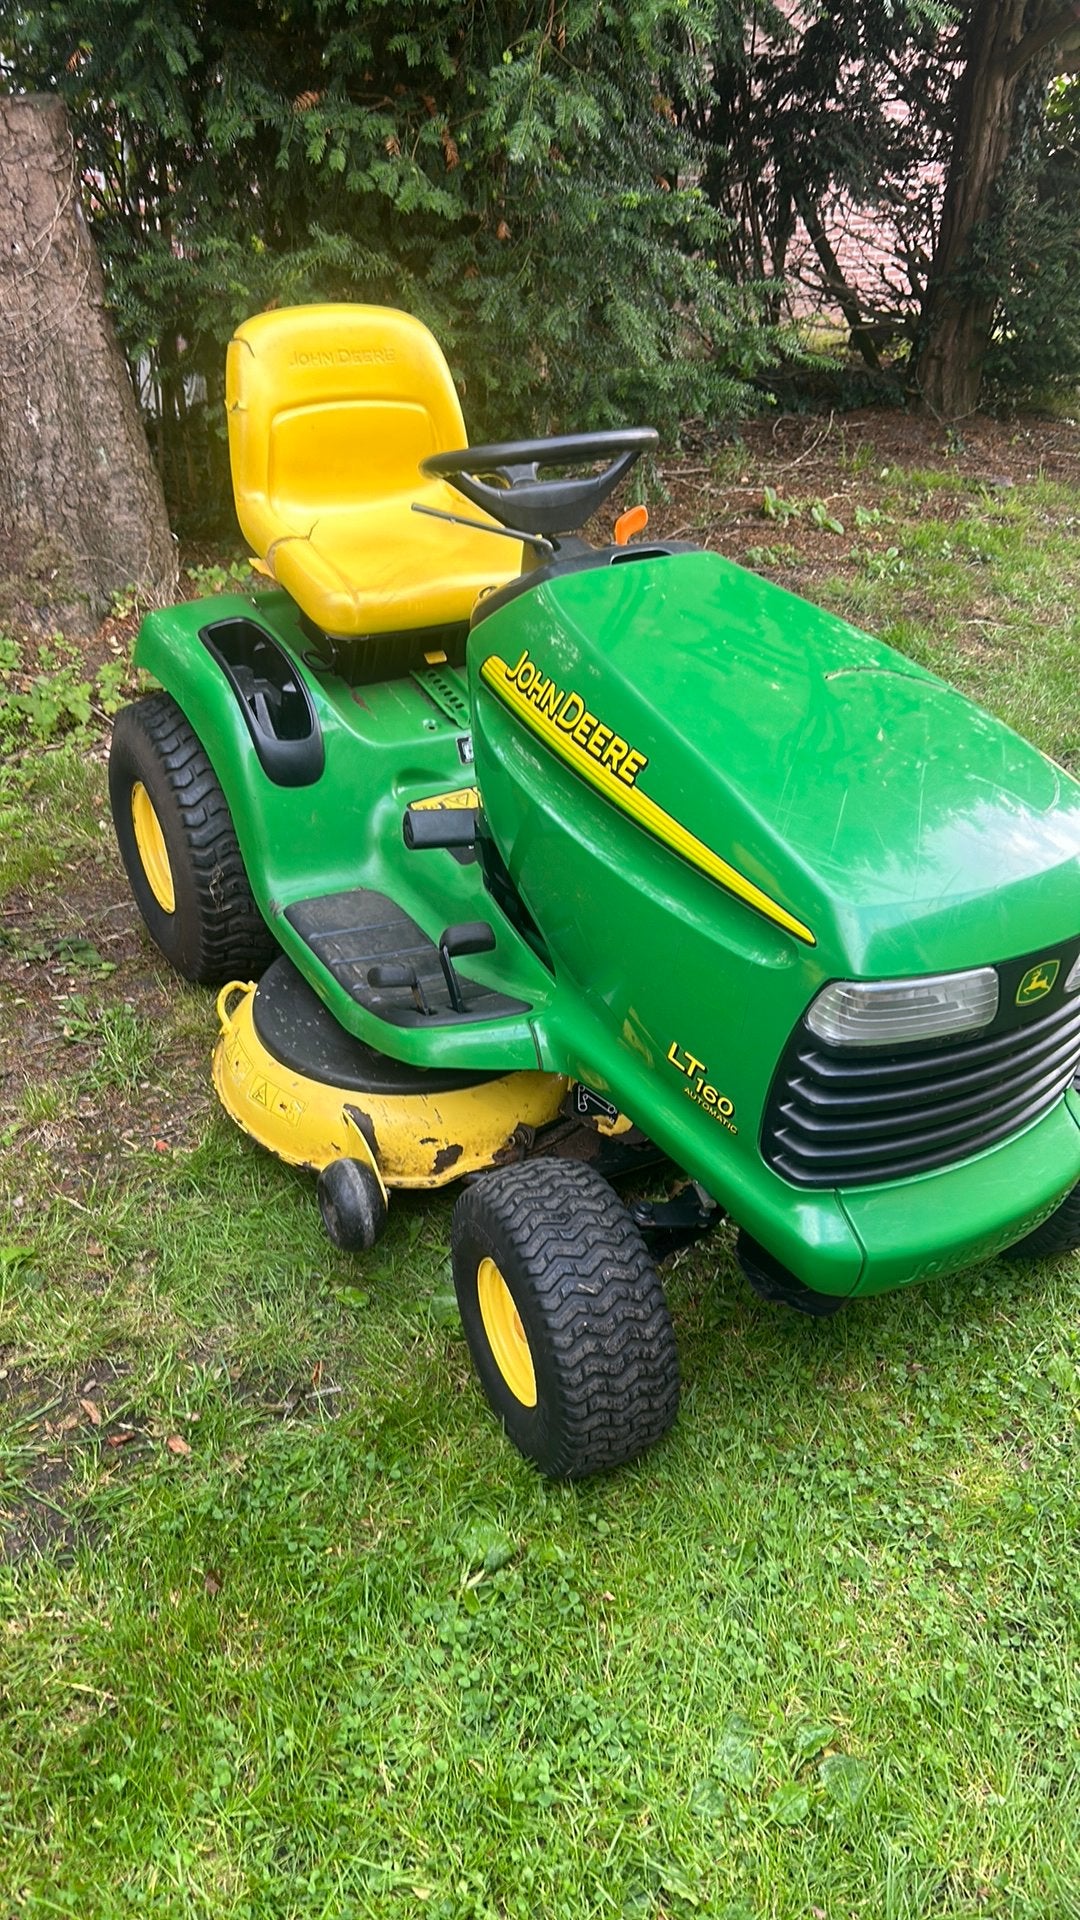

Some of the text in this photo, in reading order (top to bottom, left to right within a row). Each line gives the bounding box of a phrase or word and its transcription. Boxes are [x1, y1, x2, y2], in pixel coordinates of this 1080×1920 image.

[289, 347, 395, 367] JOHN DEERE
[506, 650, 648, 787] JOHN DEERE
[667, 1041, 735, 1118] LT 160
[684, 1087, 738, 1134] AUTOMATIC
